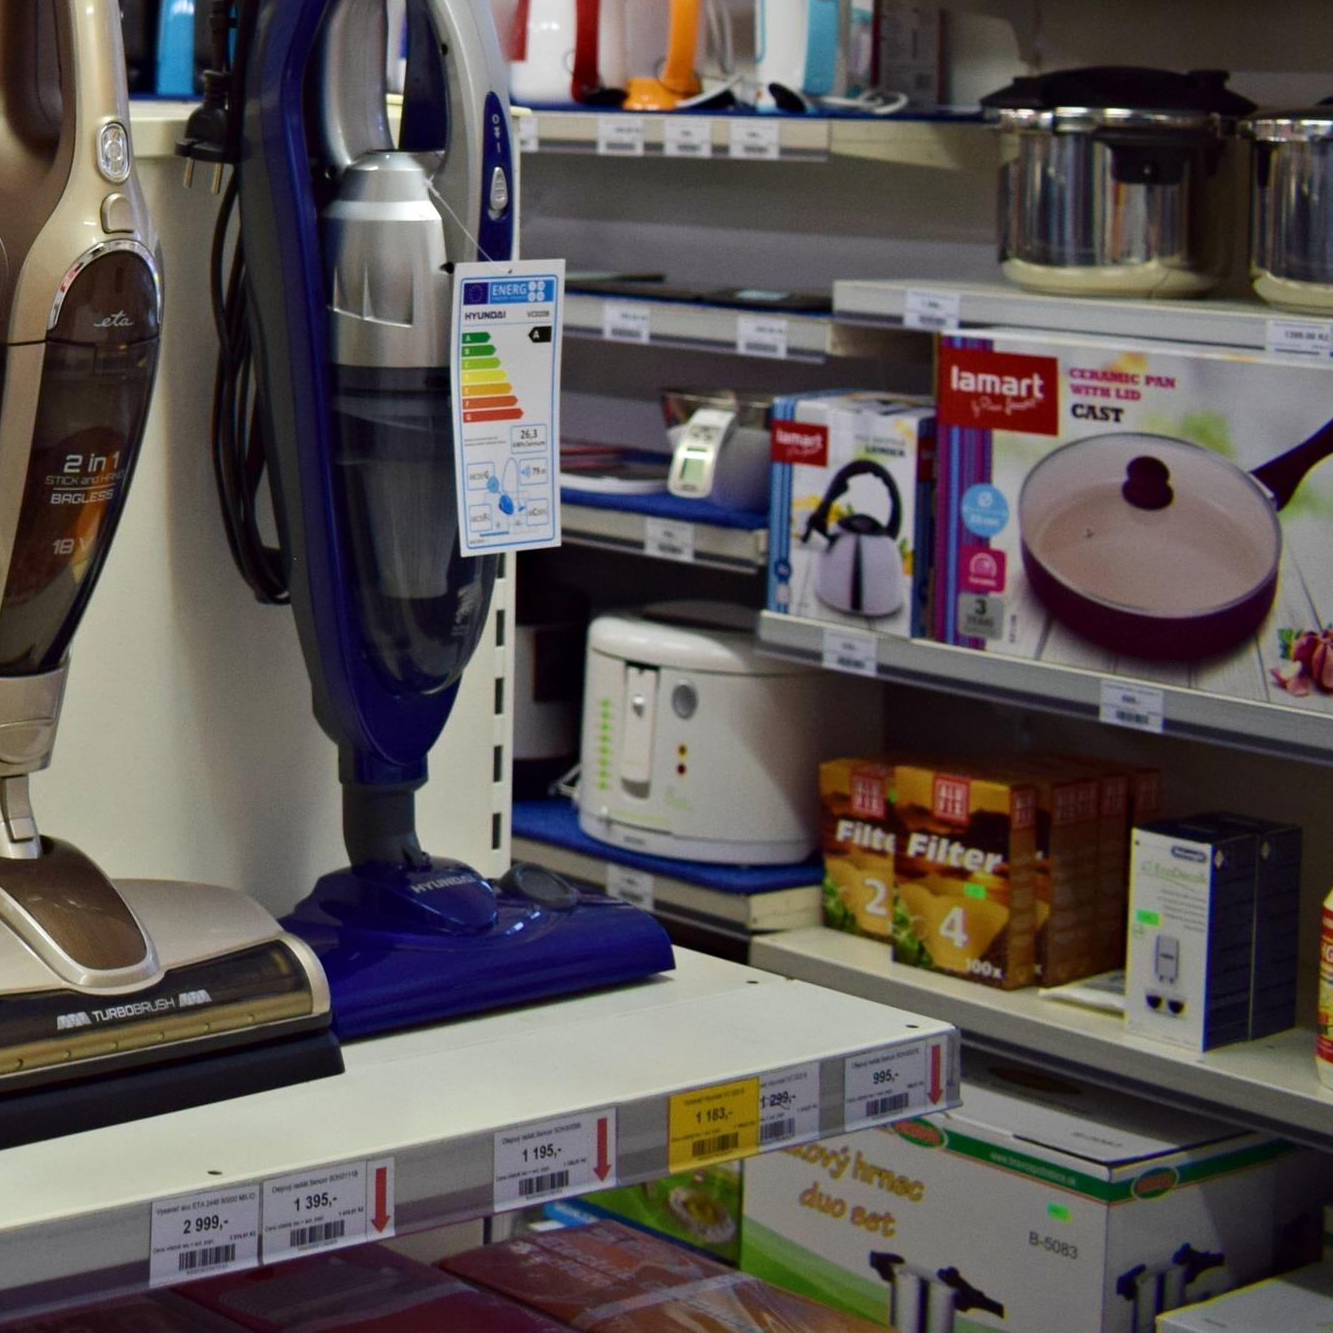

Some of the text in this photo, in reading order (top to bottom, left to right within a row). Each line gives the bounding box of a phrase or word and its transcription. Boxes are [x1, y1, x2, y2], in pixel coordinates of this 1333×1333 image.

[492, 283, 528, 297] ENERG
[94, 310, 134, 327] eta
[464, 310, 507, 321] HYUNDAI
[533, 330, 540, 339] A
[950, 364, 1045, 400] lamart
[1069, 367, 1177, 389] CERAMIC PAN
[1070, 383, 1142, 401] WITH LID
[1071, 403, 1125, 423] CAST
[775, 428, 823, 450] lamart
[63, 450, 121, 473] 2 in 1
[50, 487, 115, 505] BAGLESS
[52, 538, 75, 556] 18
[907, 832, 1005, 874] Filter
[864, 878, 889, 916] 2
[938, 906, 969, 949] 4
[91, 996, 176, 1024] TURBOBRUSH
[522, 1143, 562, 1163] 1 195,-
[852, 1151, 925, 1204] hrnec
[294, 1197, 300, 1212] 1
[305, 1191, 338, 1211] 395,-
[798, 1183, 896, 1239] duo set
[183, 1214, 229, 1235] 2 999,-
[1028, 1229, 1079, 1261] B-5083
